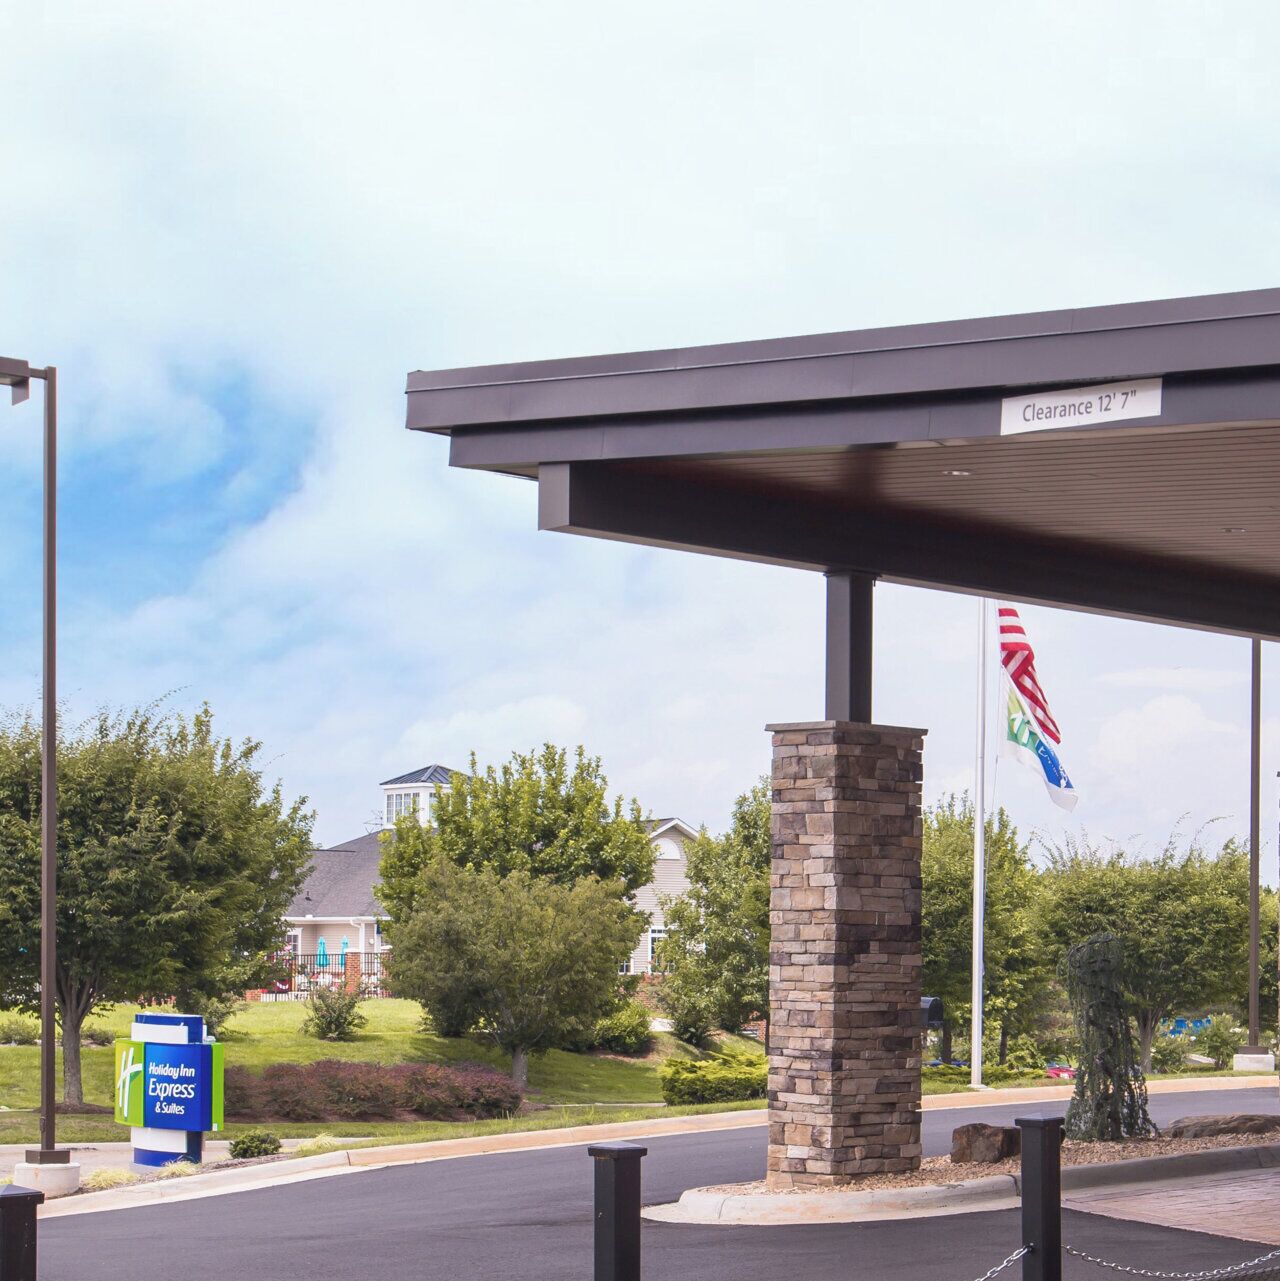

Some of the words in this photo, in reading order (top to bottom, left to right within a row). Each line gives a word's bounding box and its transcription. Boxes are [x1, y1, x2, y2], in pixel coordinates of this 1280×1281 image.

[1022, 402, 1093, 422] Clearance
[1098, 393, 1116, 413] 12'
[148, 1062, 179, 1079] Holiday
[180, 1064, 195, 1077] Inn
[148, 1078, 195, 1101] Express
[155, 1102, 161, 1113] &
[161, 1102, 185, 1115] Suites
